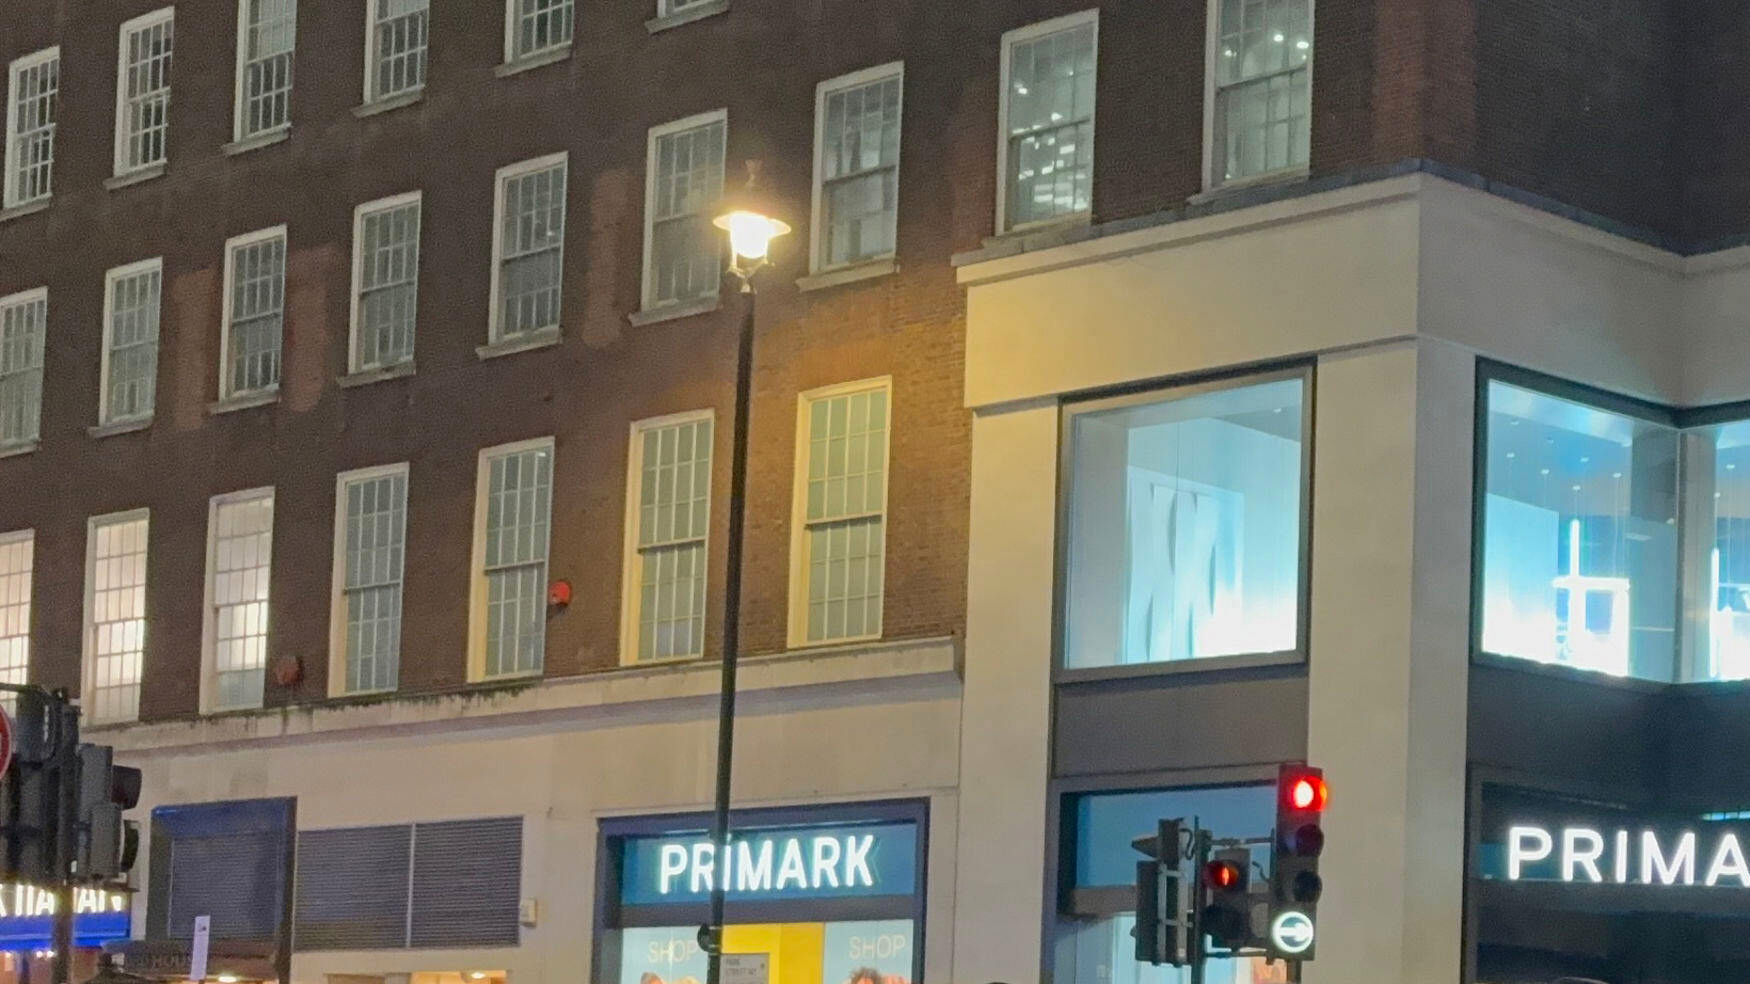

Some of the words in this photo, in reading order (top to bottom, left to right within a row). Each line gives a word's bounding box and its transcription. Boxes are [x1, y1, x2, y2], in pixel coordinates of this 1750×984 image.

[660, 834, 874, 894] PRIMARK
[648, 937, 699, 964] SHOP
[849, 934, 907, 960] SHOP
